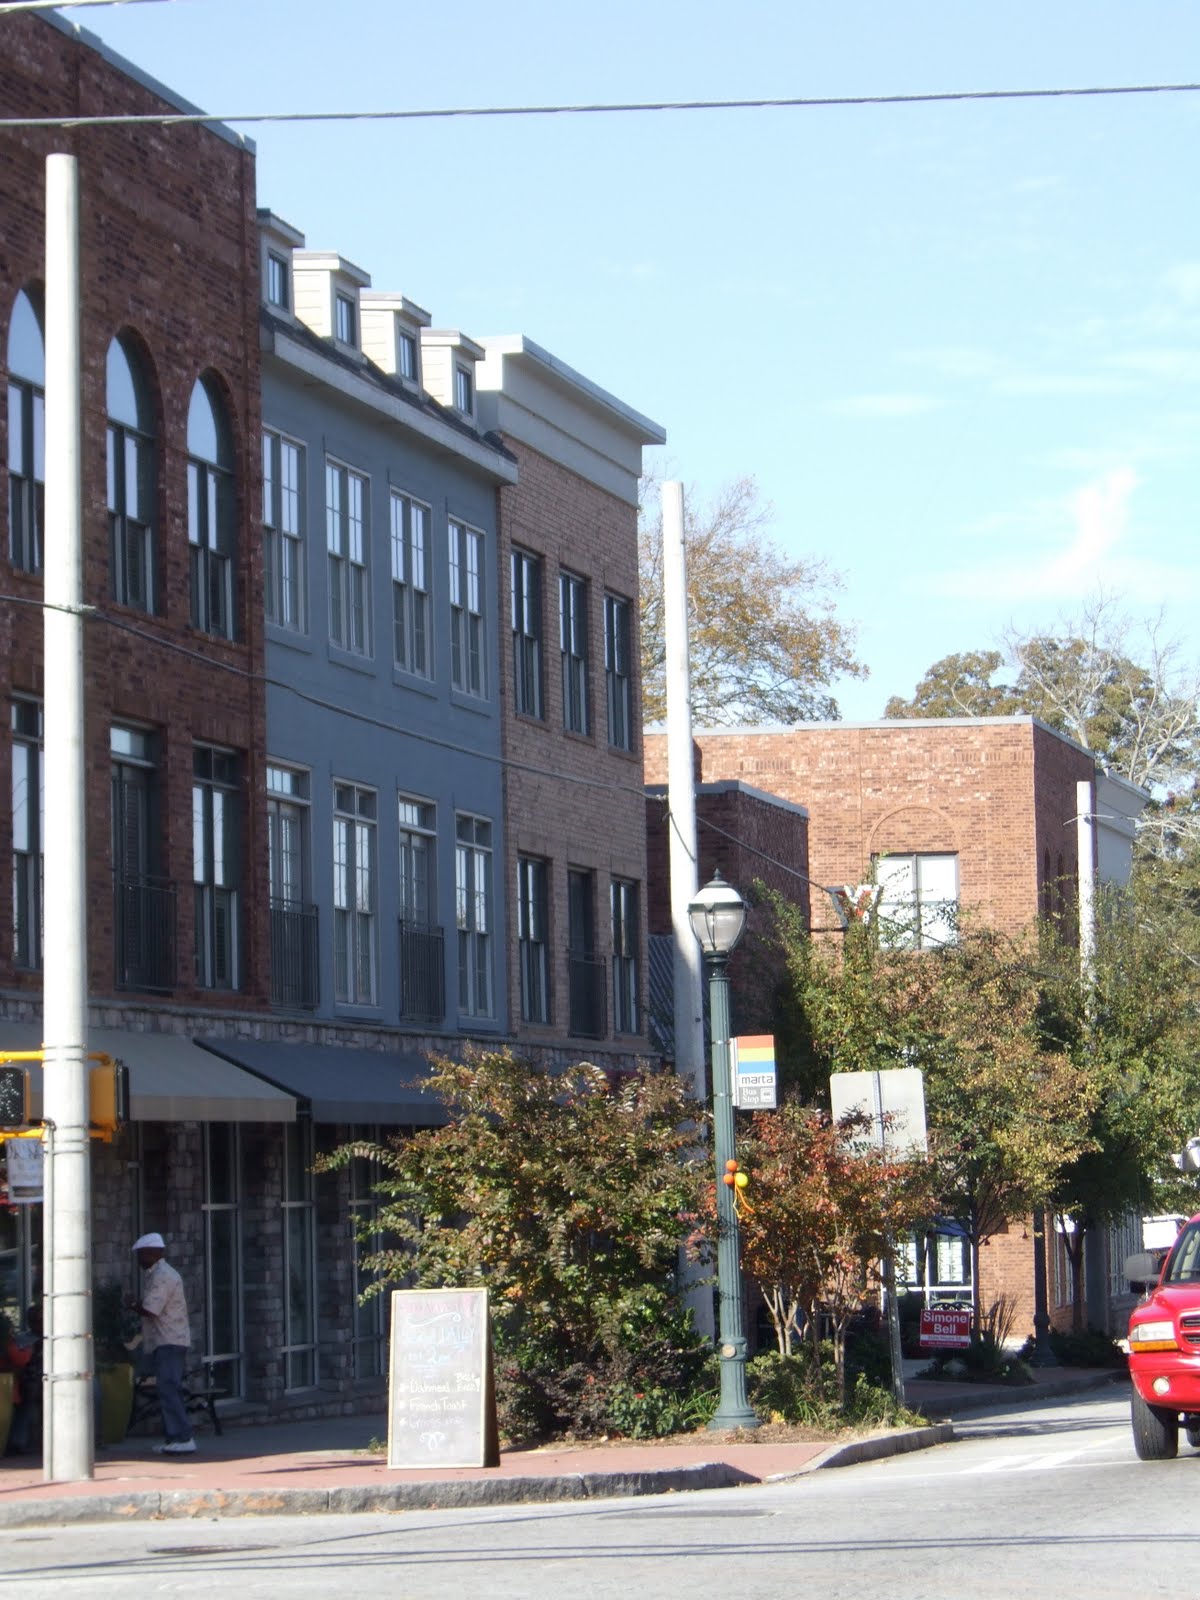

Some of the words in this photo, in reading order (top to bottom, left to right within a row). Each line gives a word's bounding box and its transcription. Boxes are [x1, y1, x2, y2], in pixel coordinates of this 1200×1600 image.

[741, 1075, 774, 1085] marta
[742, 1087, 757, 1096] Bus
[742, 1096, 760, 1105] Stop
[923, 1311, 967, 1323] Simone
[933, 1323, 956, 1334] Bell
